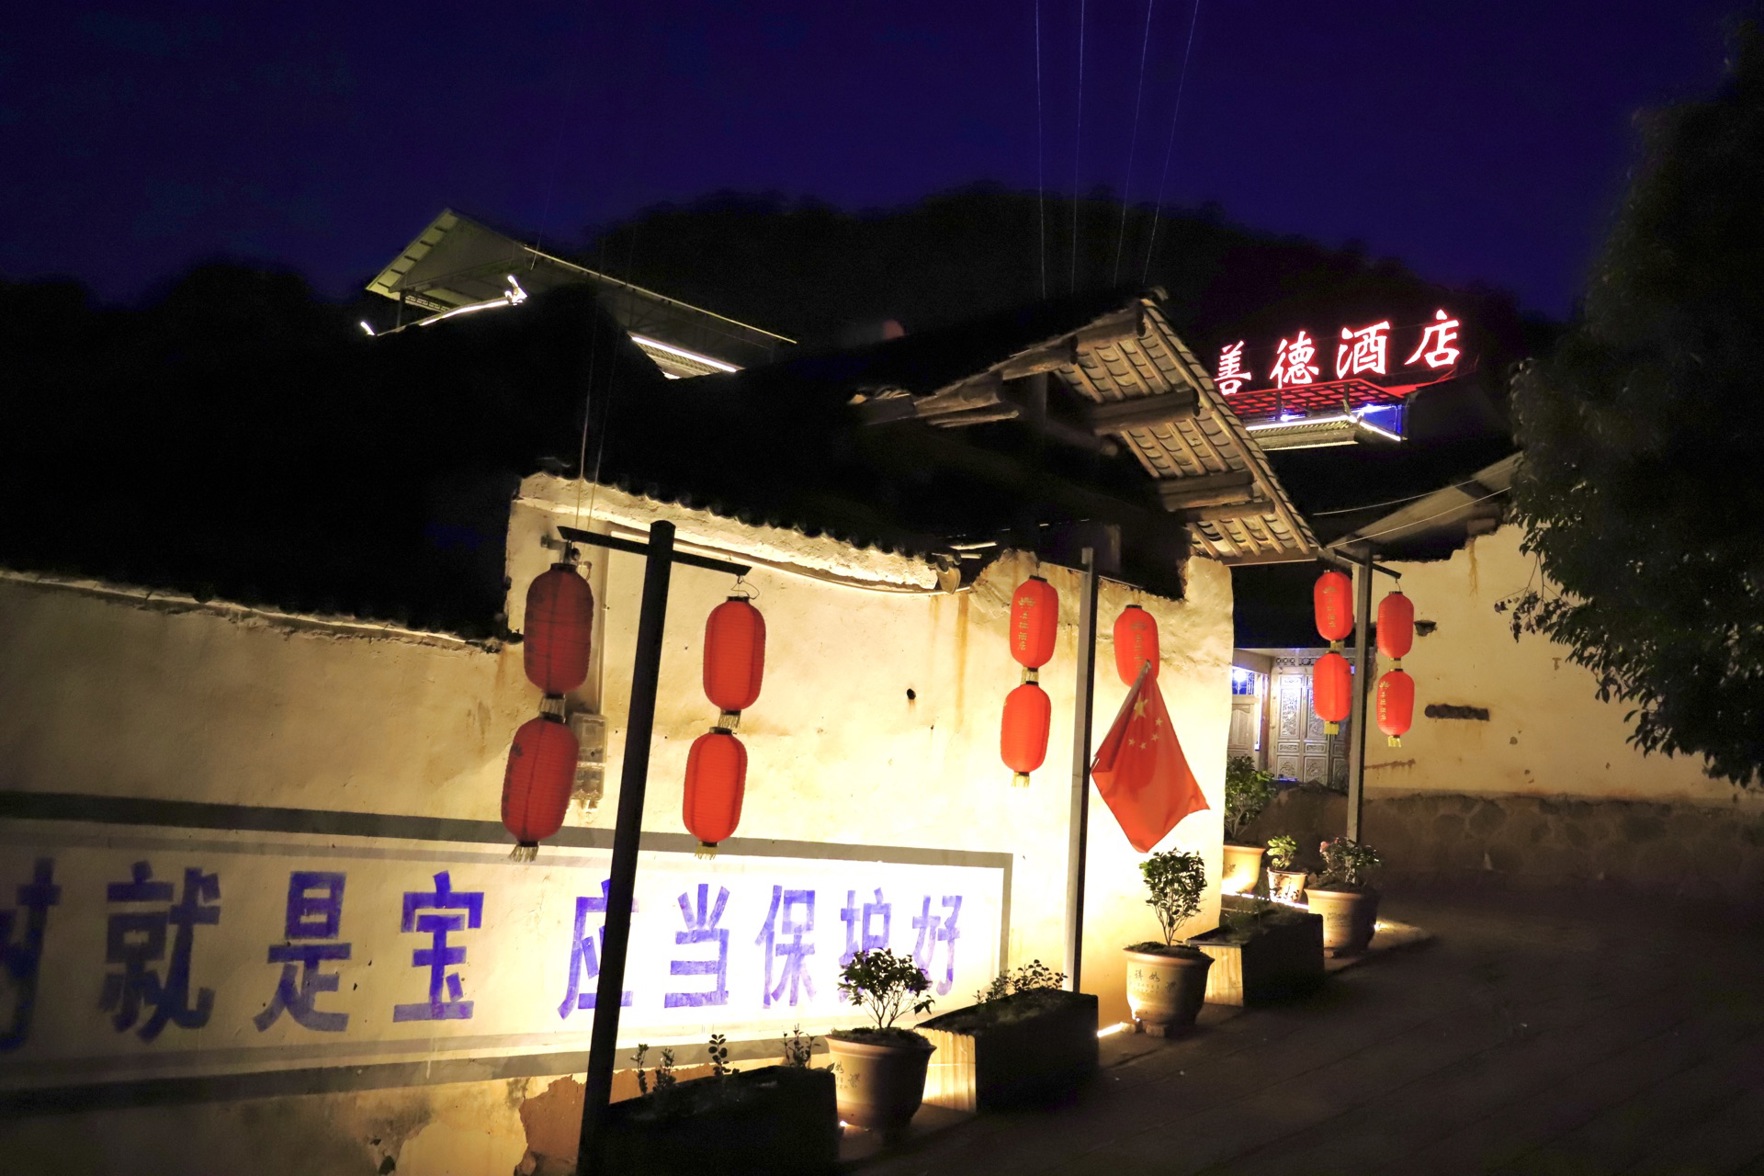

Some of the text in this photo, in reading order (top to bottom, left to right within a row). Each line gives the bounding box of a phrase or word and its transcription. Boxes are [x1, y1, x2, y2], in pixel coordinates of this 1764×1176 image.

[1214, 309, 1460, 396] 善德酒店
[557, 878, 963, 1020] 应当保护好
